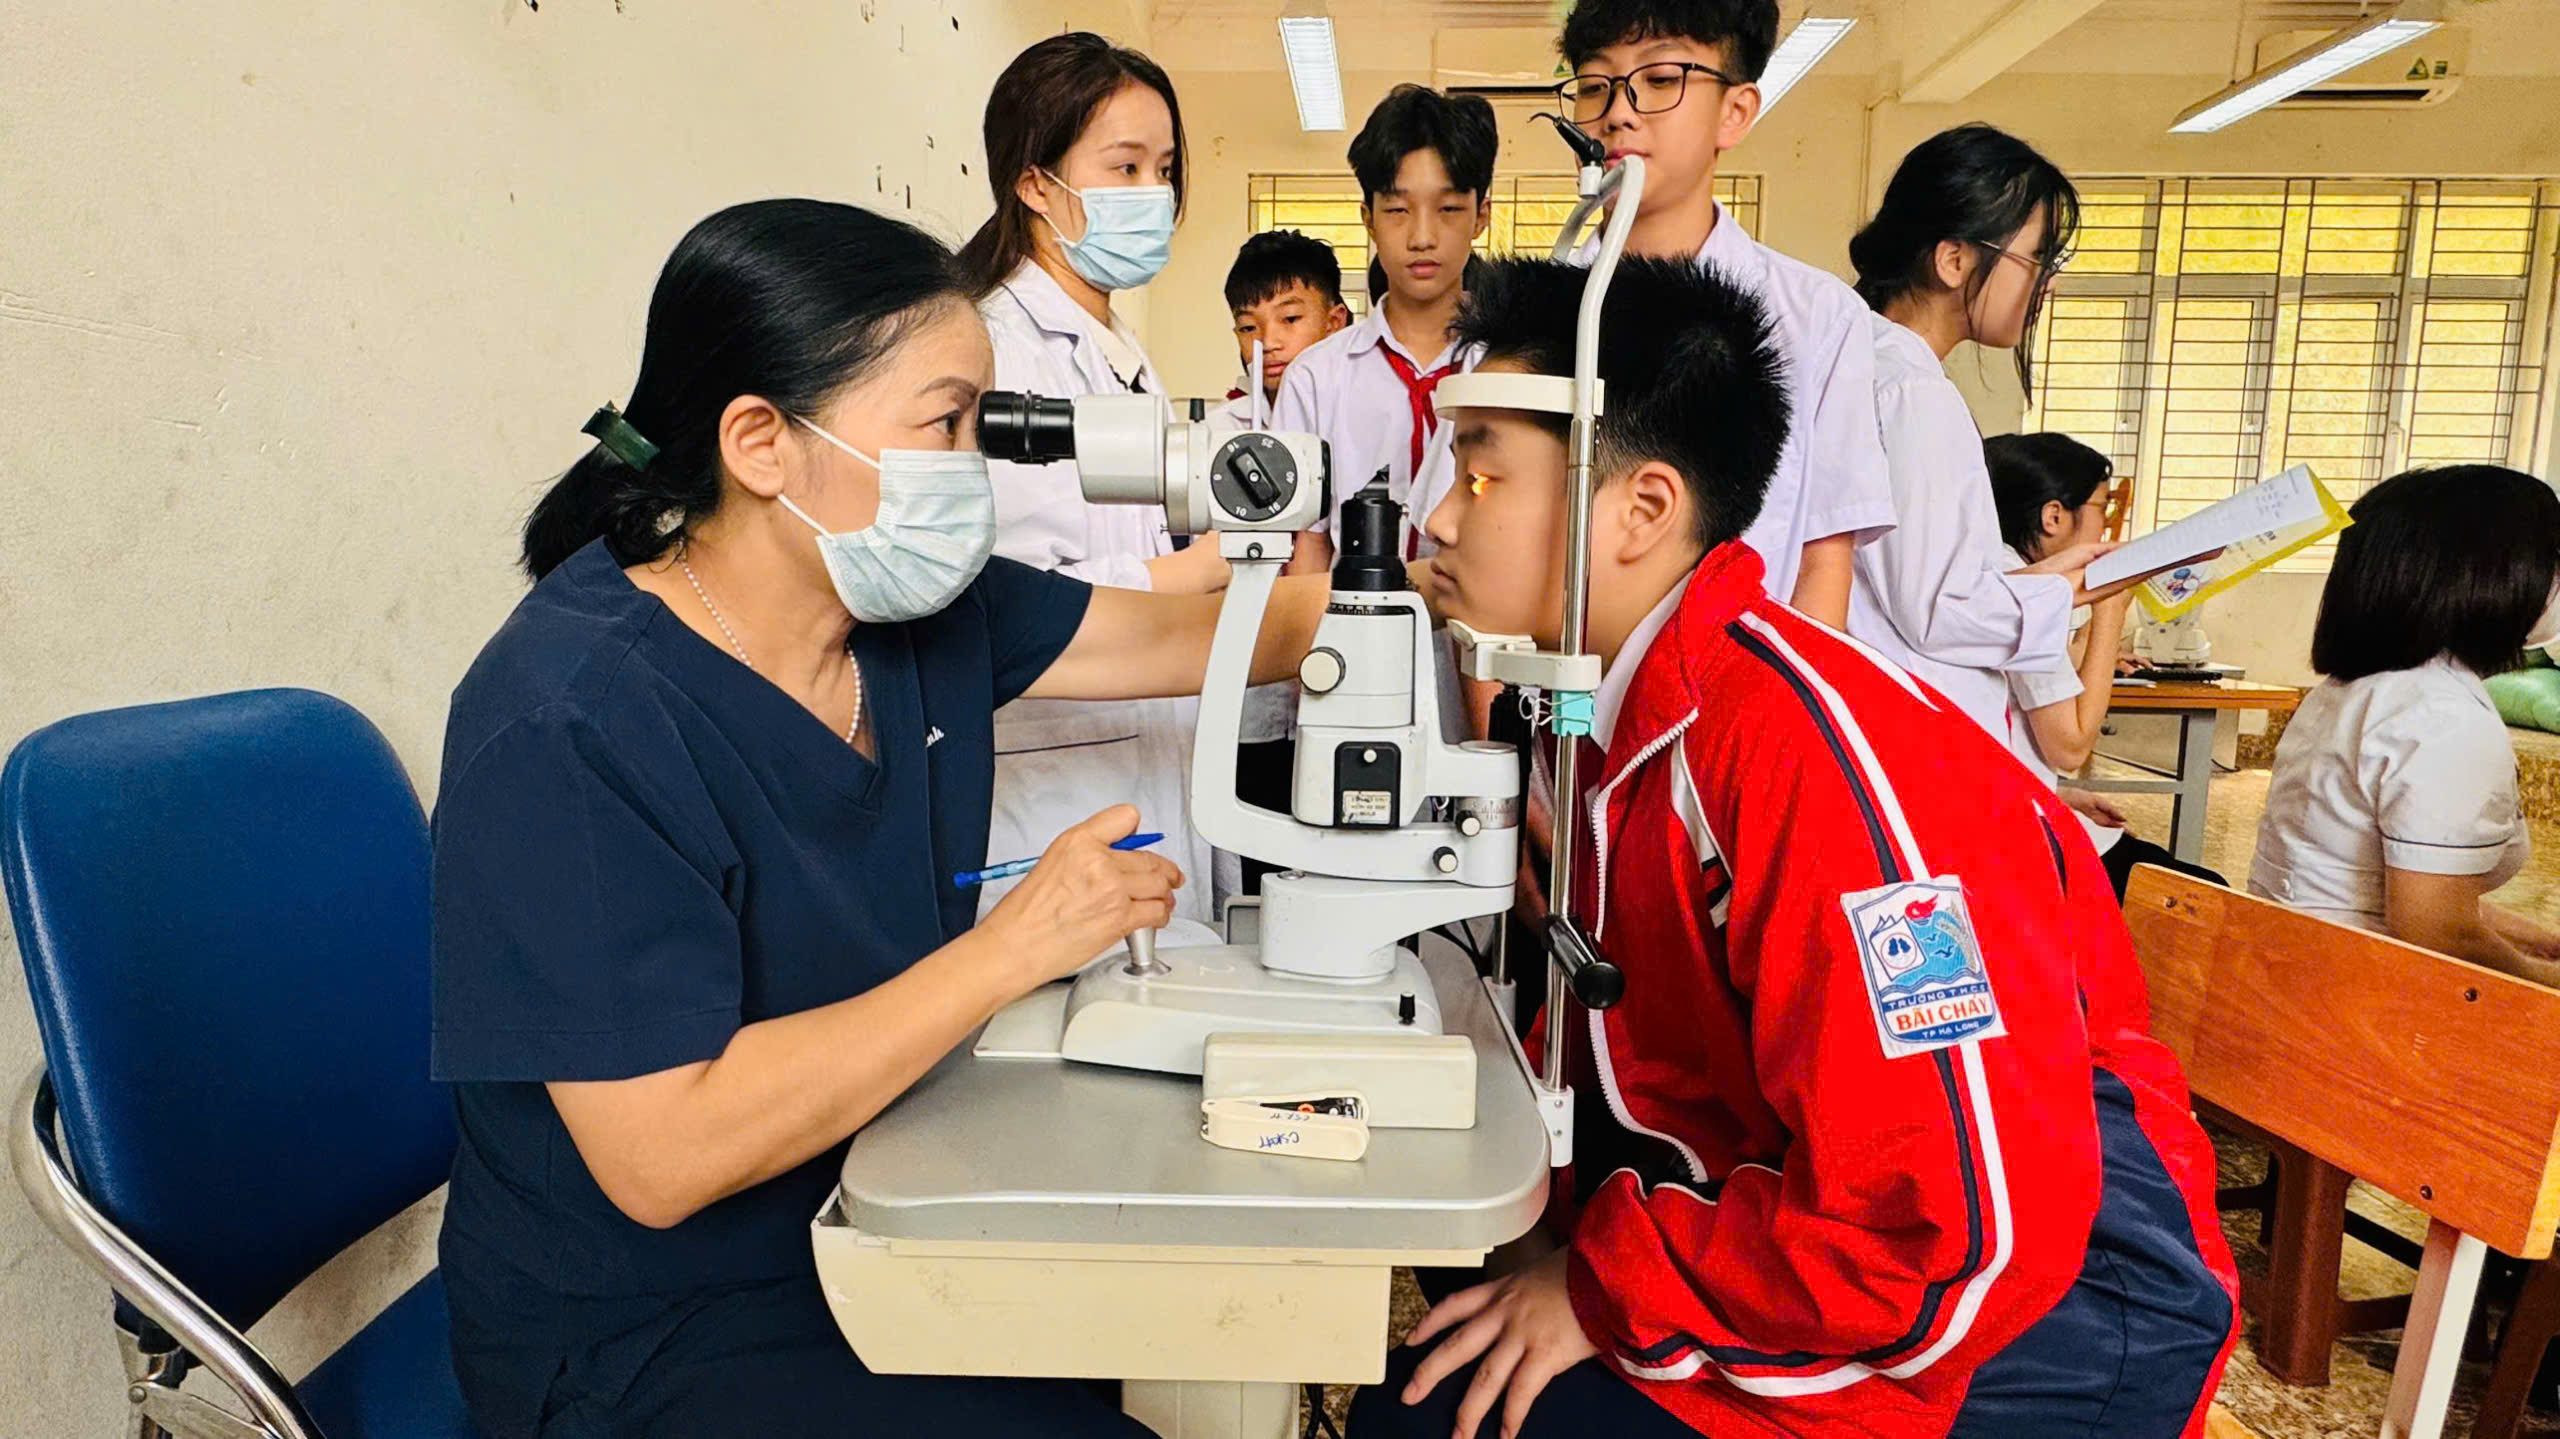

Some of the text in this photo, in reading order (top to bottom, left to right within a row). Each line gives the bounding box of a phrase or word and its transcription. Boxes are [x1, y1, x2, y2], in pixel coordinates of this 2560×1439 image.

[1226, 441, 1240, 453] 16
[1261, 438, 1275, 449] 25
[1285, 471, 1295, 484] 40
[1235, 506, 1247, 517] 10
[1268, 502, 1281, 514] 16
[1938, 993, 1988, 1021] CHÁY
[1922, 1030, 1936, 1039] TP
